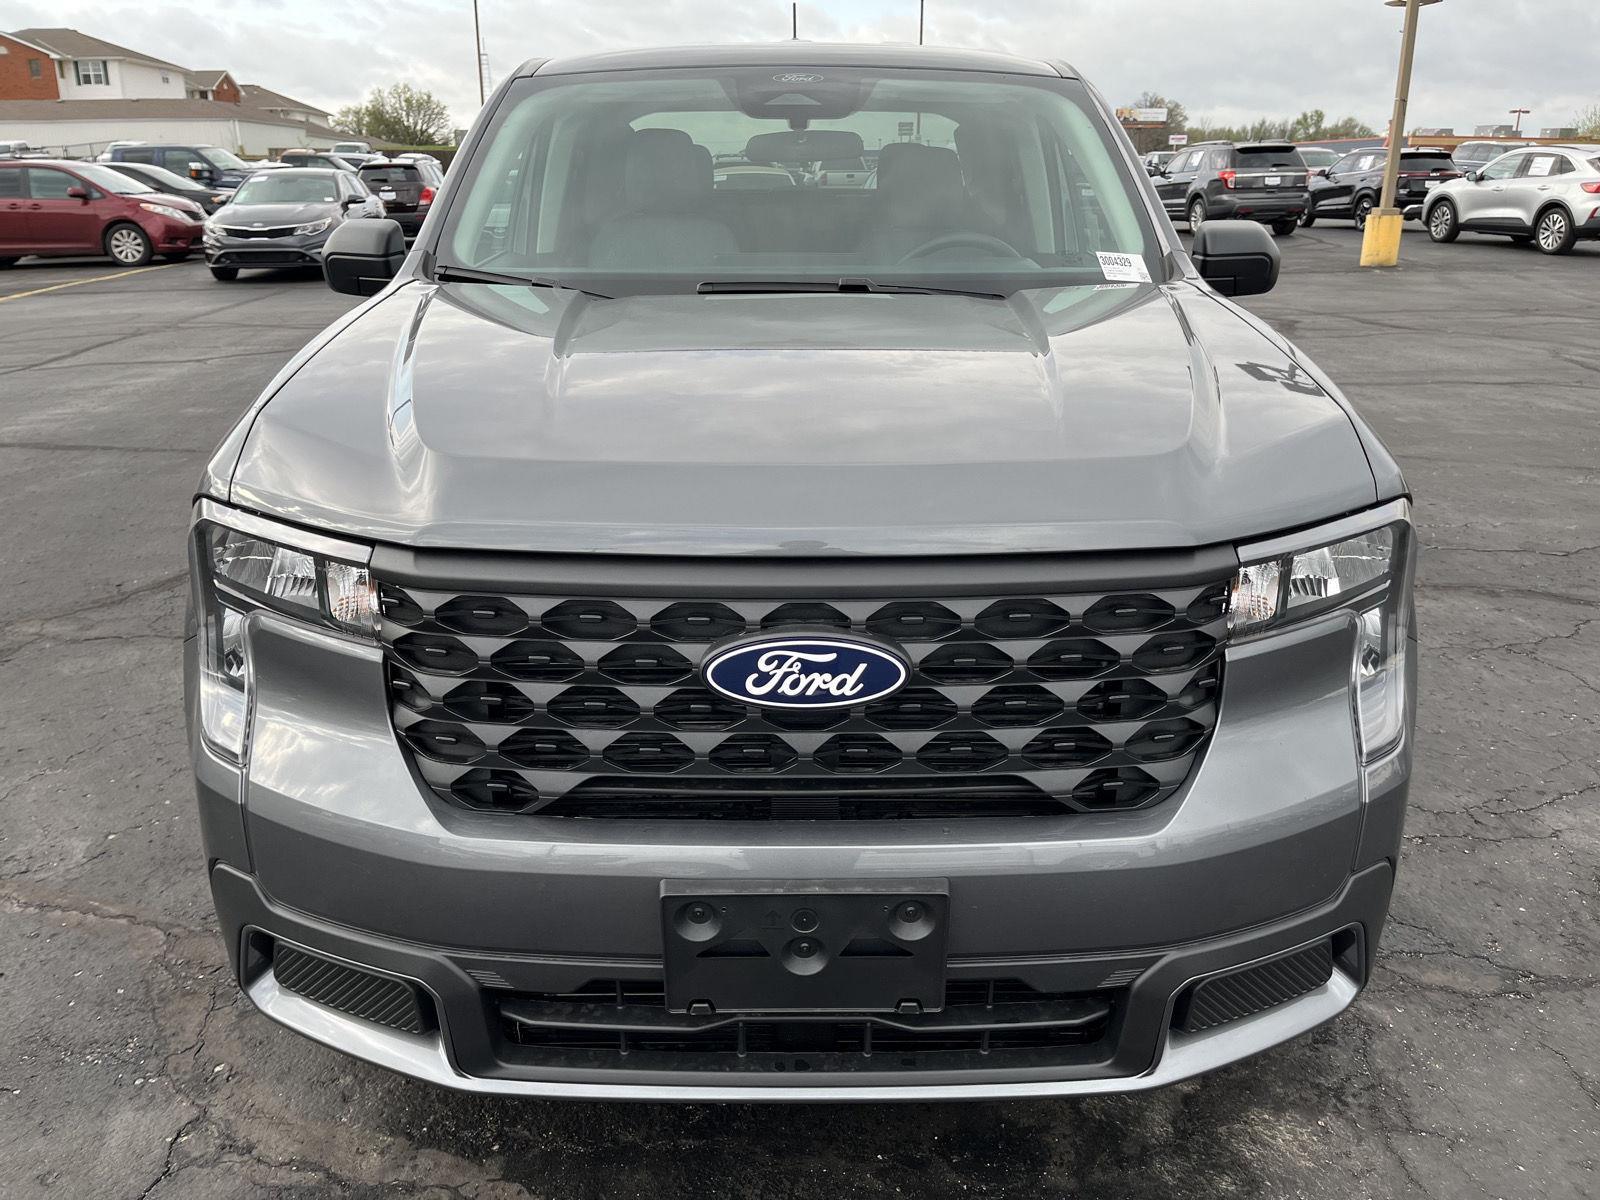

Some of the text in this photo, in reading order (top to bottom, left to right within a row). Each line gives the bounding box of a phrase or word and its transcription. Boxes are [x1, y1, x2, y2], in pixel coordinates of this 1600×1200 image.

[782, 73, 816, 82] Ford
[1099, 255, 1132, 267] 3004329
[745, 650, 868, 696] Ford
